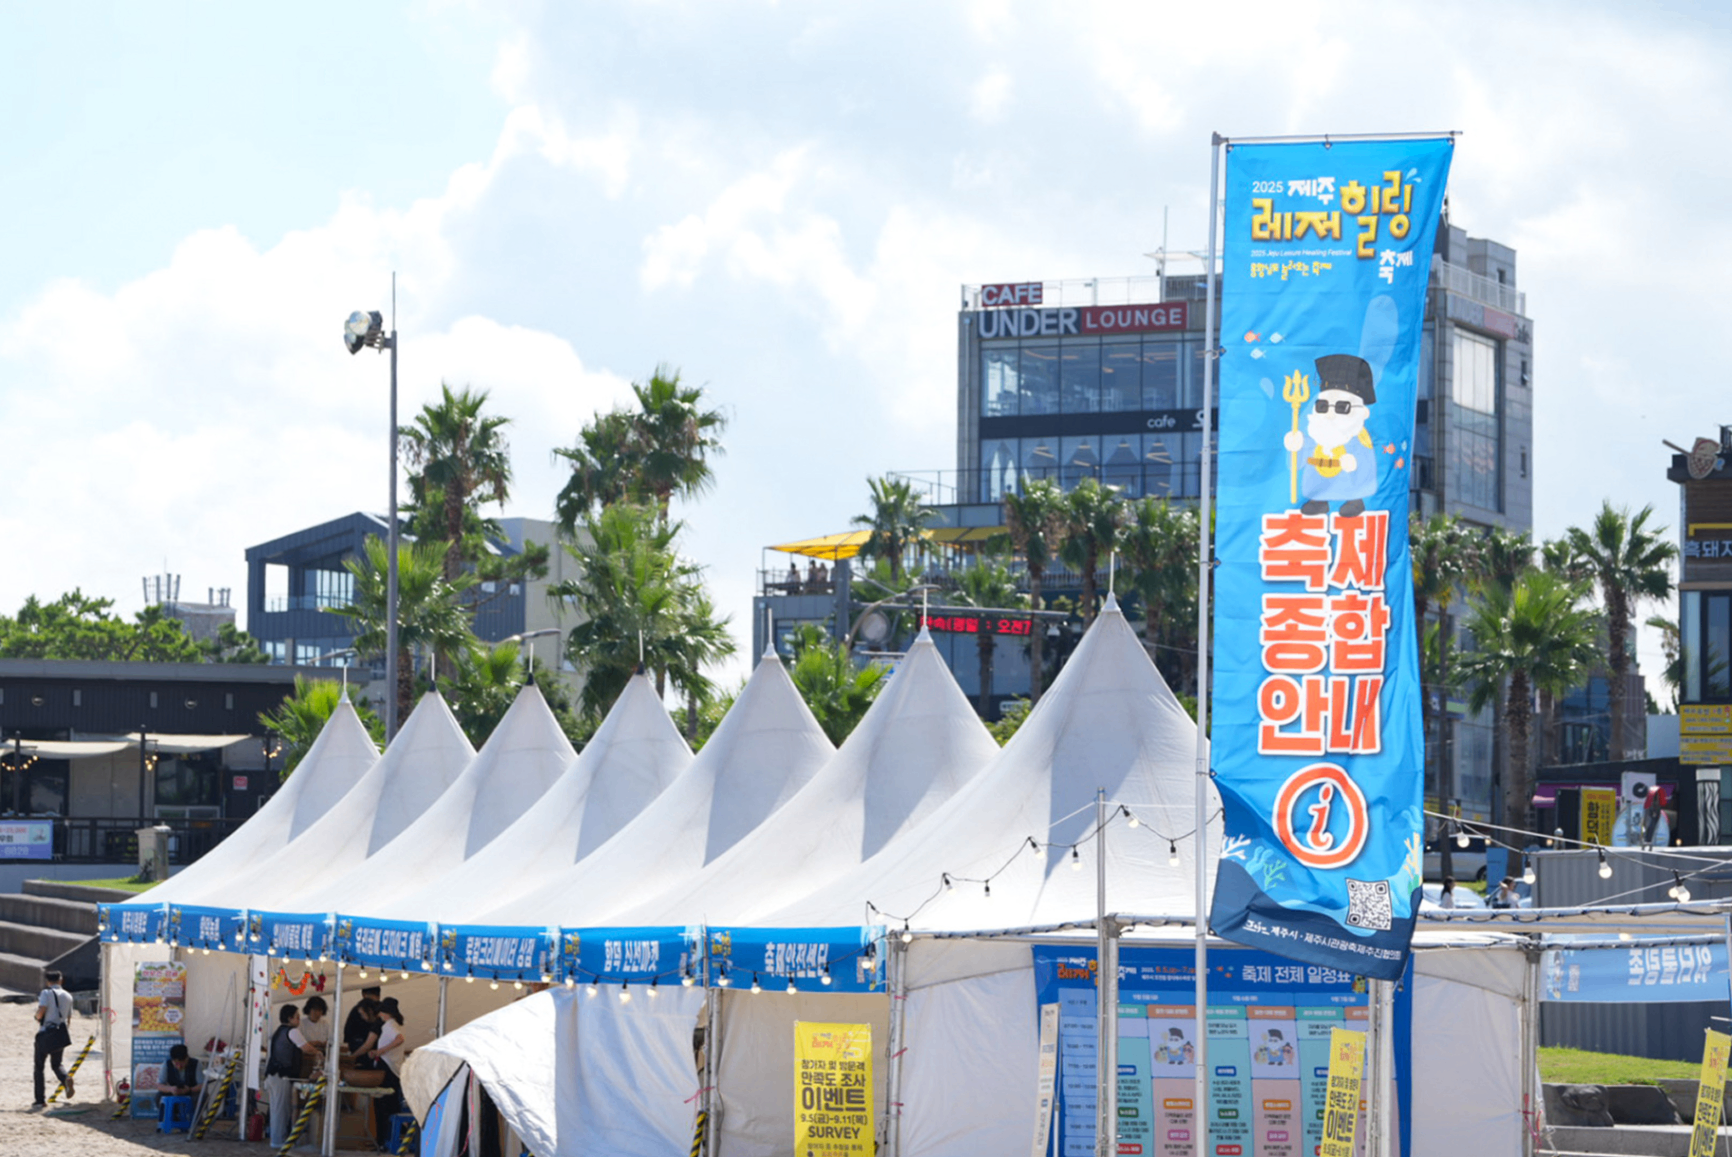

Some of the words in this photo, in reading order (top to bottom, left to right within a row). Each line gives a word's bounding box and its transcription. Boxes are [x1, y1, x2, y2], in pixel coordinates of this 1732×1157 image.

[1252, 181, 1284, 193] 2025
[1287, 177, 1336, 205] 제주
[1340, 171, 1413, 258] 힐링
[1378, 249, 1414, 284] 축제
[982, 283, 1042, 306] CAFE
[978, 308, 1078, 338] UNDER
[1086, 308, 1183, 329] LOUNGE
[1147, 414, 1176, 428] cafe
[1259, 509, 1389, 592] 축제
[1260, 591, 1390, 674] 종합
[1258, 674, 1384, 755] 안내
[1271, 926, 1299, 941] 제주시
[604, 939, 622, 972] 함덕
[764, 942, 829, 978] 축제안전센터
[1242, 964, 1271, 983] 축제
[1274, 965, 1304, 984] 전체
[801, 1071, 837, 1086] 만족도
[841, 1073, 866, 1087] 조사
[802, 1087, 866, 1112] 이벤트
[808, 1126, 860, 1139] SURVEY
